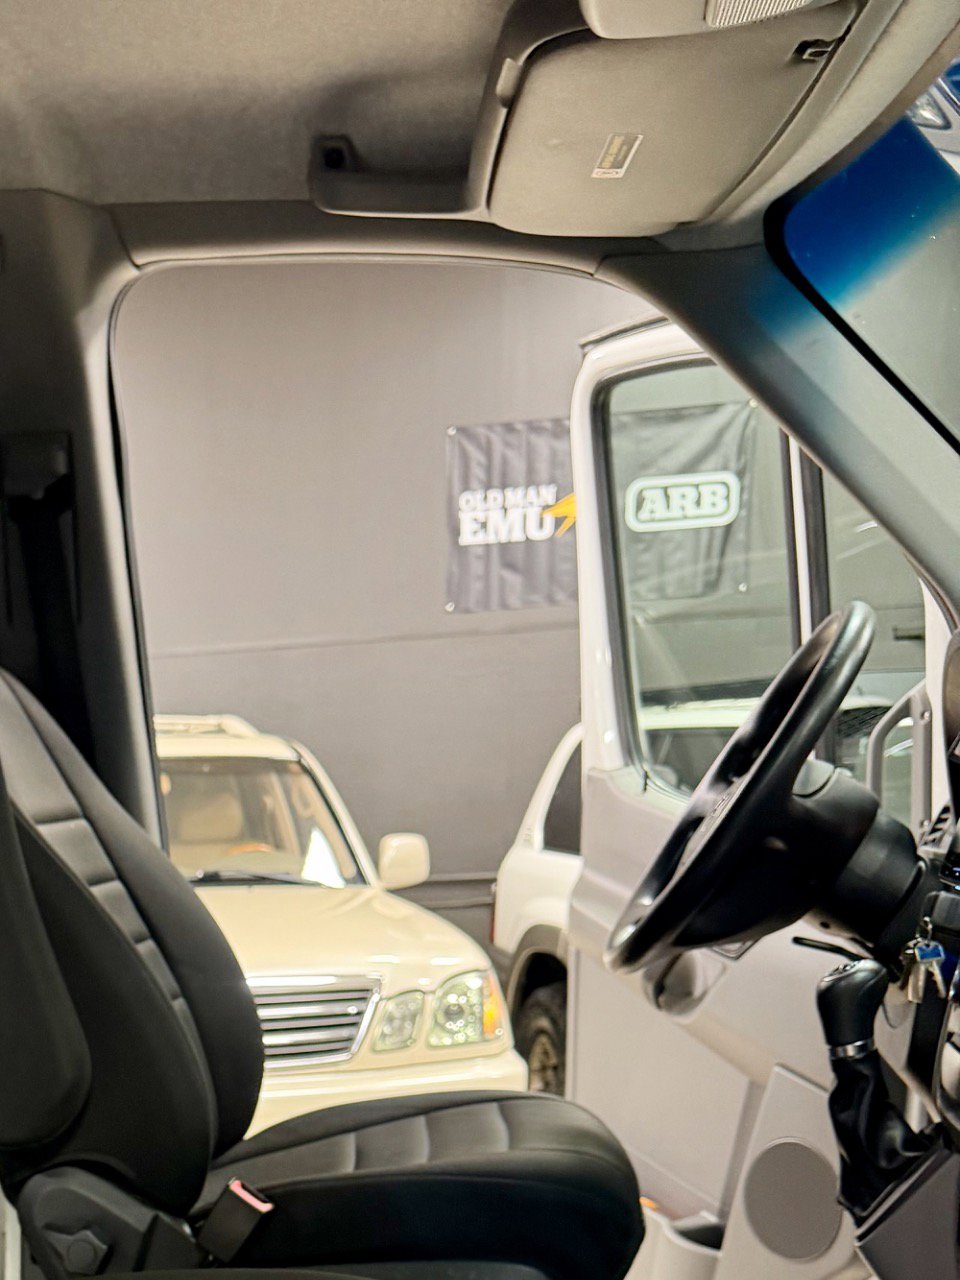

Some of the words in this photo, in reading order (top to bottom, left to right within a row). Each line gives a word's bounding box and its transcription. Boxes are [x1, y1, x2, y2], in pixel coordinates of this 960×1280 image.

[458, 488, 504, 511] OLD
[504, 483, 558, 509] MAN
[638, 482, 730, 521] ARB
[458, 507, 557, 546] EMU
